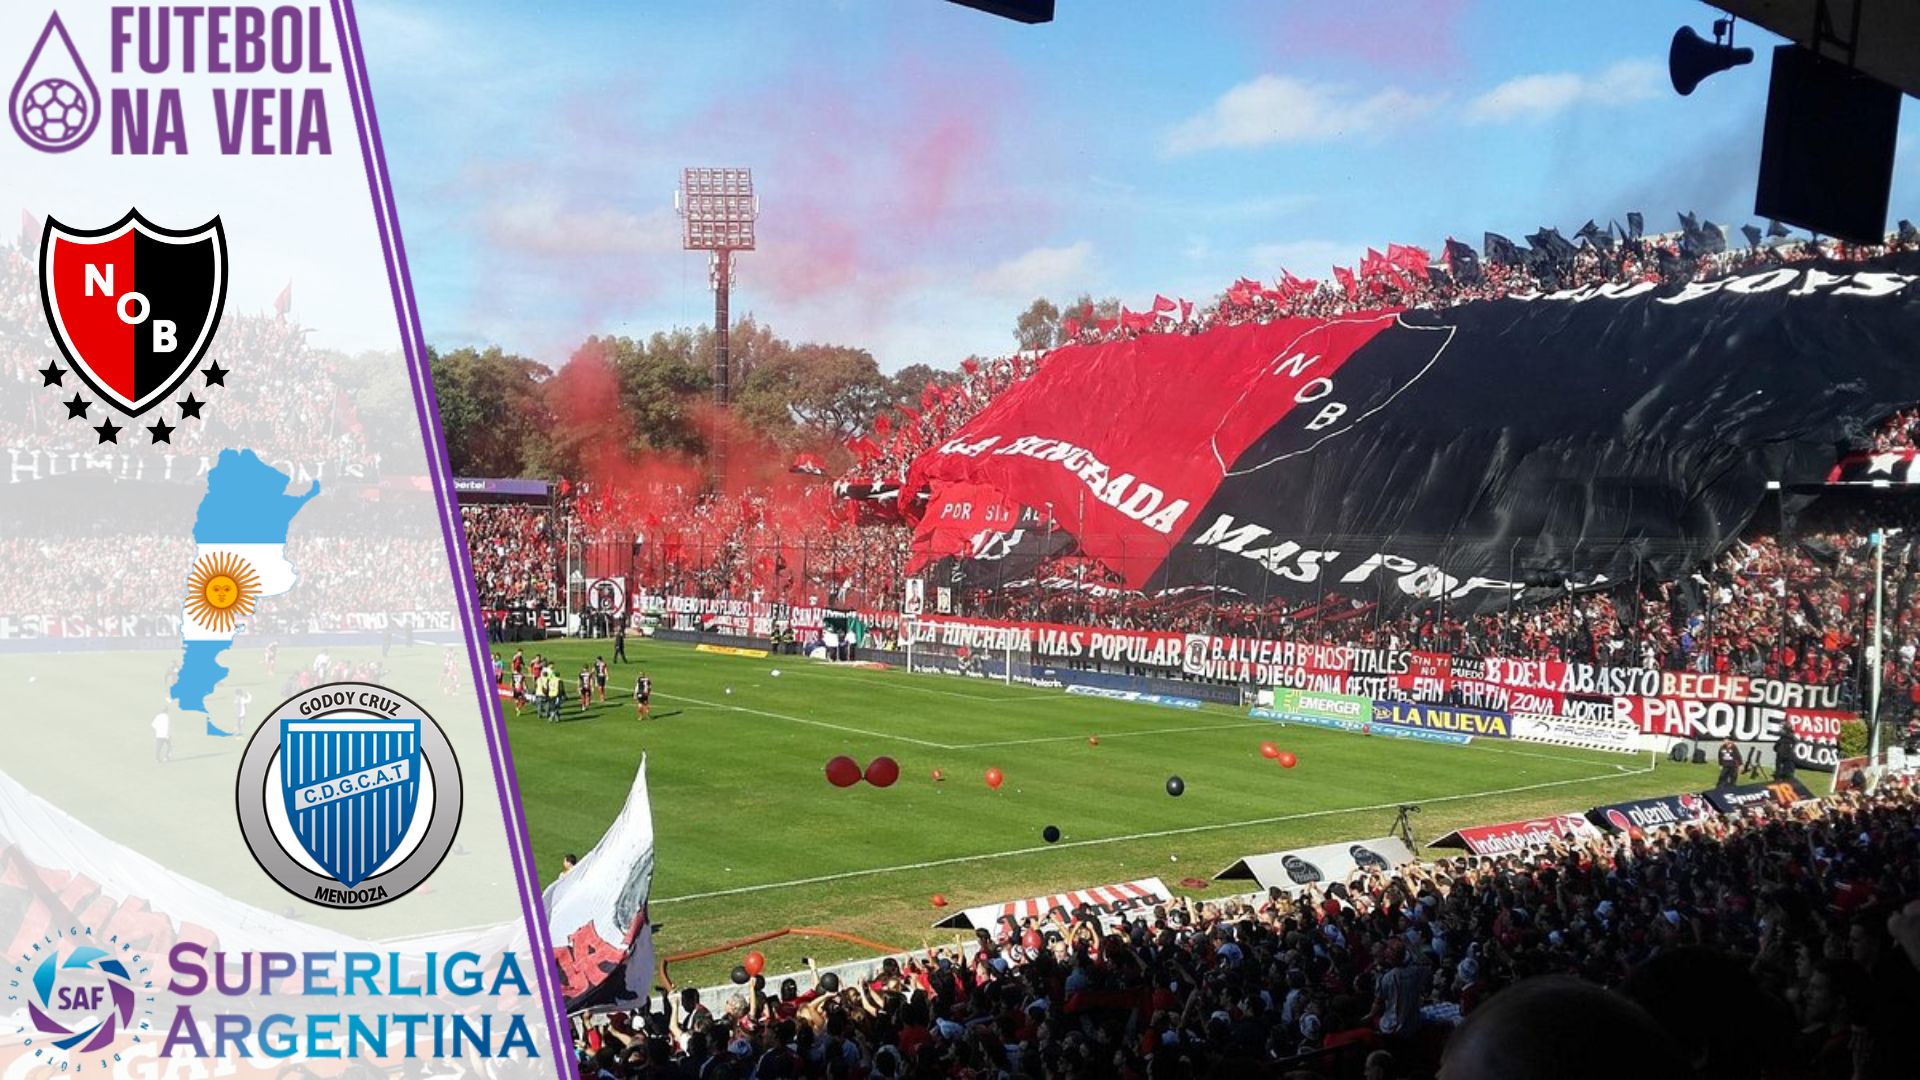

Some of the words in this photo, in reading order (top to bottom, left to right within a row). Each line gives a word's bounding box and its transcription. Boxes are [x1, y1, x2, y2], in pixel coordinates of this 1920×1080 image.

[941, 502, 972, 521] POR
[1192, 513, 1338, 582] MAS
[942, 621, 1032, 652] HINCHADA
[1038, 628, 1084, 657] MAS
[1088, 632, 1183, 667] POPULAR
[1228, 638, 1295, 667] ALVEAR
[1206, 660, 1250, 683] VILLA
[1257, 663, 1306, 689] DIEGO
[1313, 645, 1412, 675] HOSPITALES
[1412, 677, 1444, 702] SAN
[1504, 660, 1556, 690] DEL
[1558, 662, 1660, 697] ABASTO
[1300, 696, 1361, 716] EMERGER
[1392, 706, 1422, 726] LA
[1426, 708, 1508, 736] NUEVA
[1510, 692, 1554, 715] ZONA
[1561, 698, 1614, 722] NORTE
[1642, 698, 1787, 742] PARQUE
